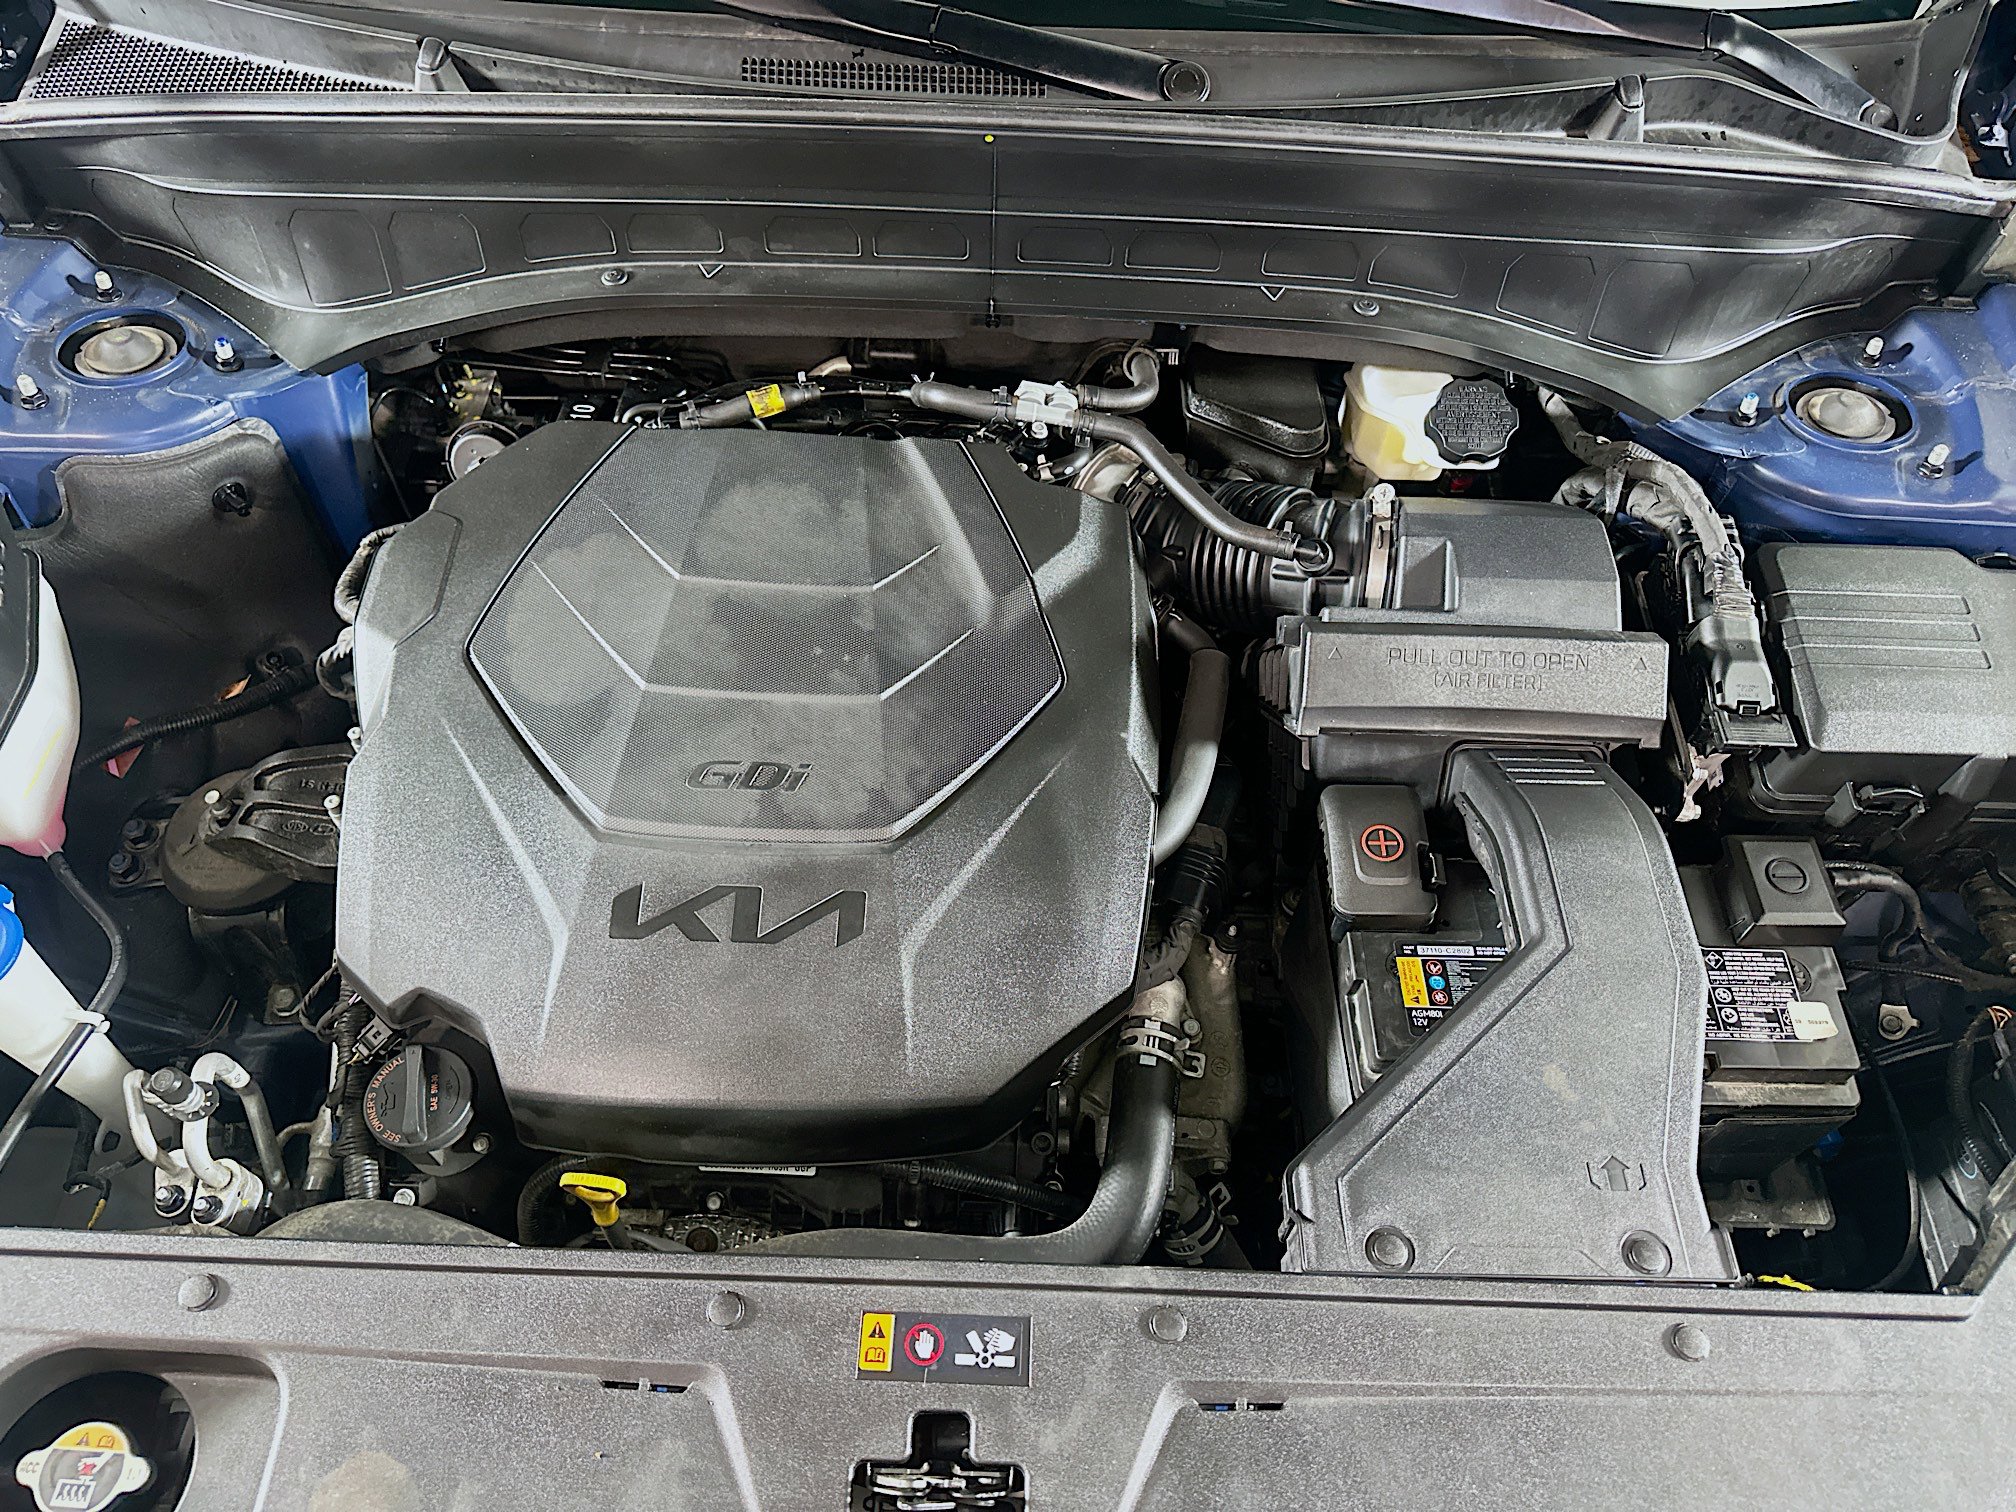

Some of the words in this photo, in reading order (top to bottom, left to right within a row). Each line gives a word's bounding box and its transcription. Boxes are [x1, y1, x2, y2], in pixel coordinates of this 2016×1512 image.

[569, 404, 595, 419] 10
[1387, 647, 1441, 666] PULL
[1449, 649, 1494, 668] OUT
[1501, 651, 1526, 669] TO
[1532, 652, 1590, 672] OPEN
[686, 760, 813, 792] GDi
[1413, 1018, 1428, 1026] 12V
[371, 1057, 405, 1089] MANUAL
[366, 1092, 384, 1132] OWNER'S
[429, 1096, 439, 1111] SAE
[383, 1129, 401, 1142] SEE
